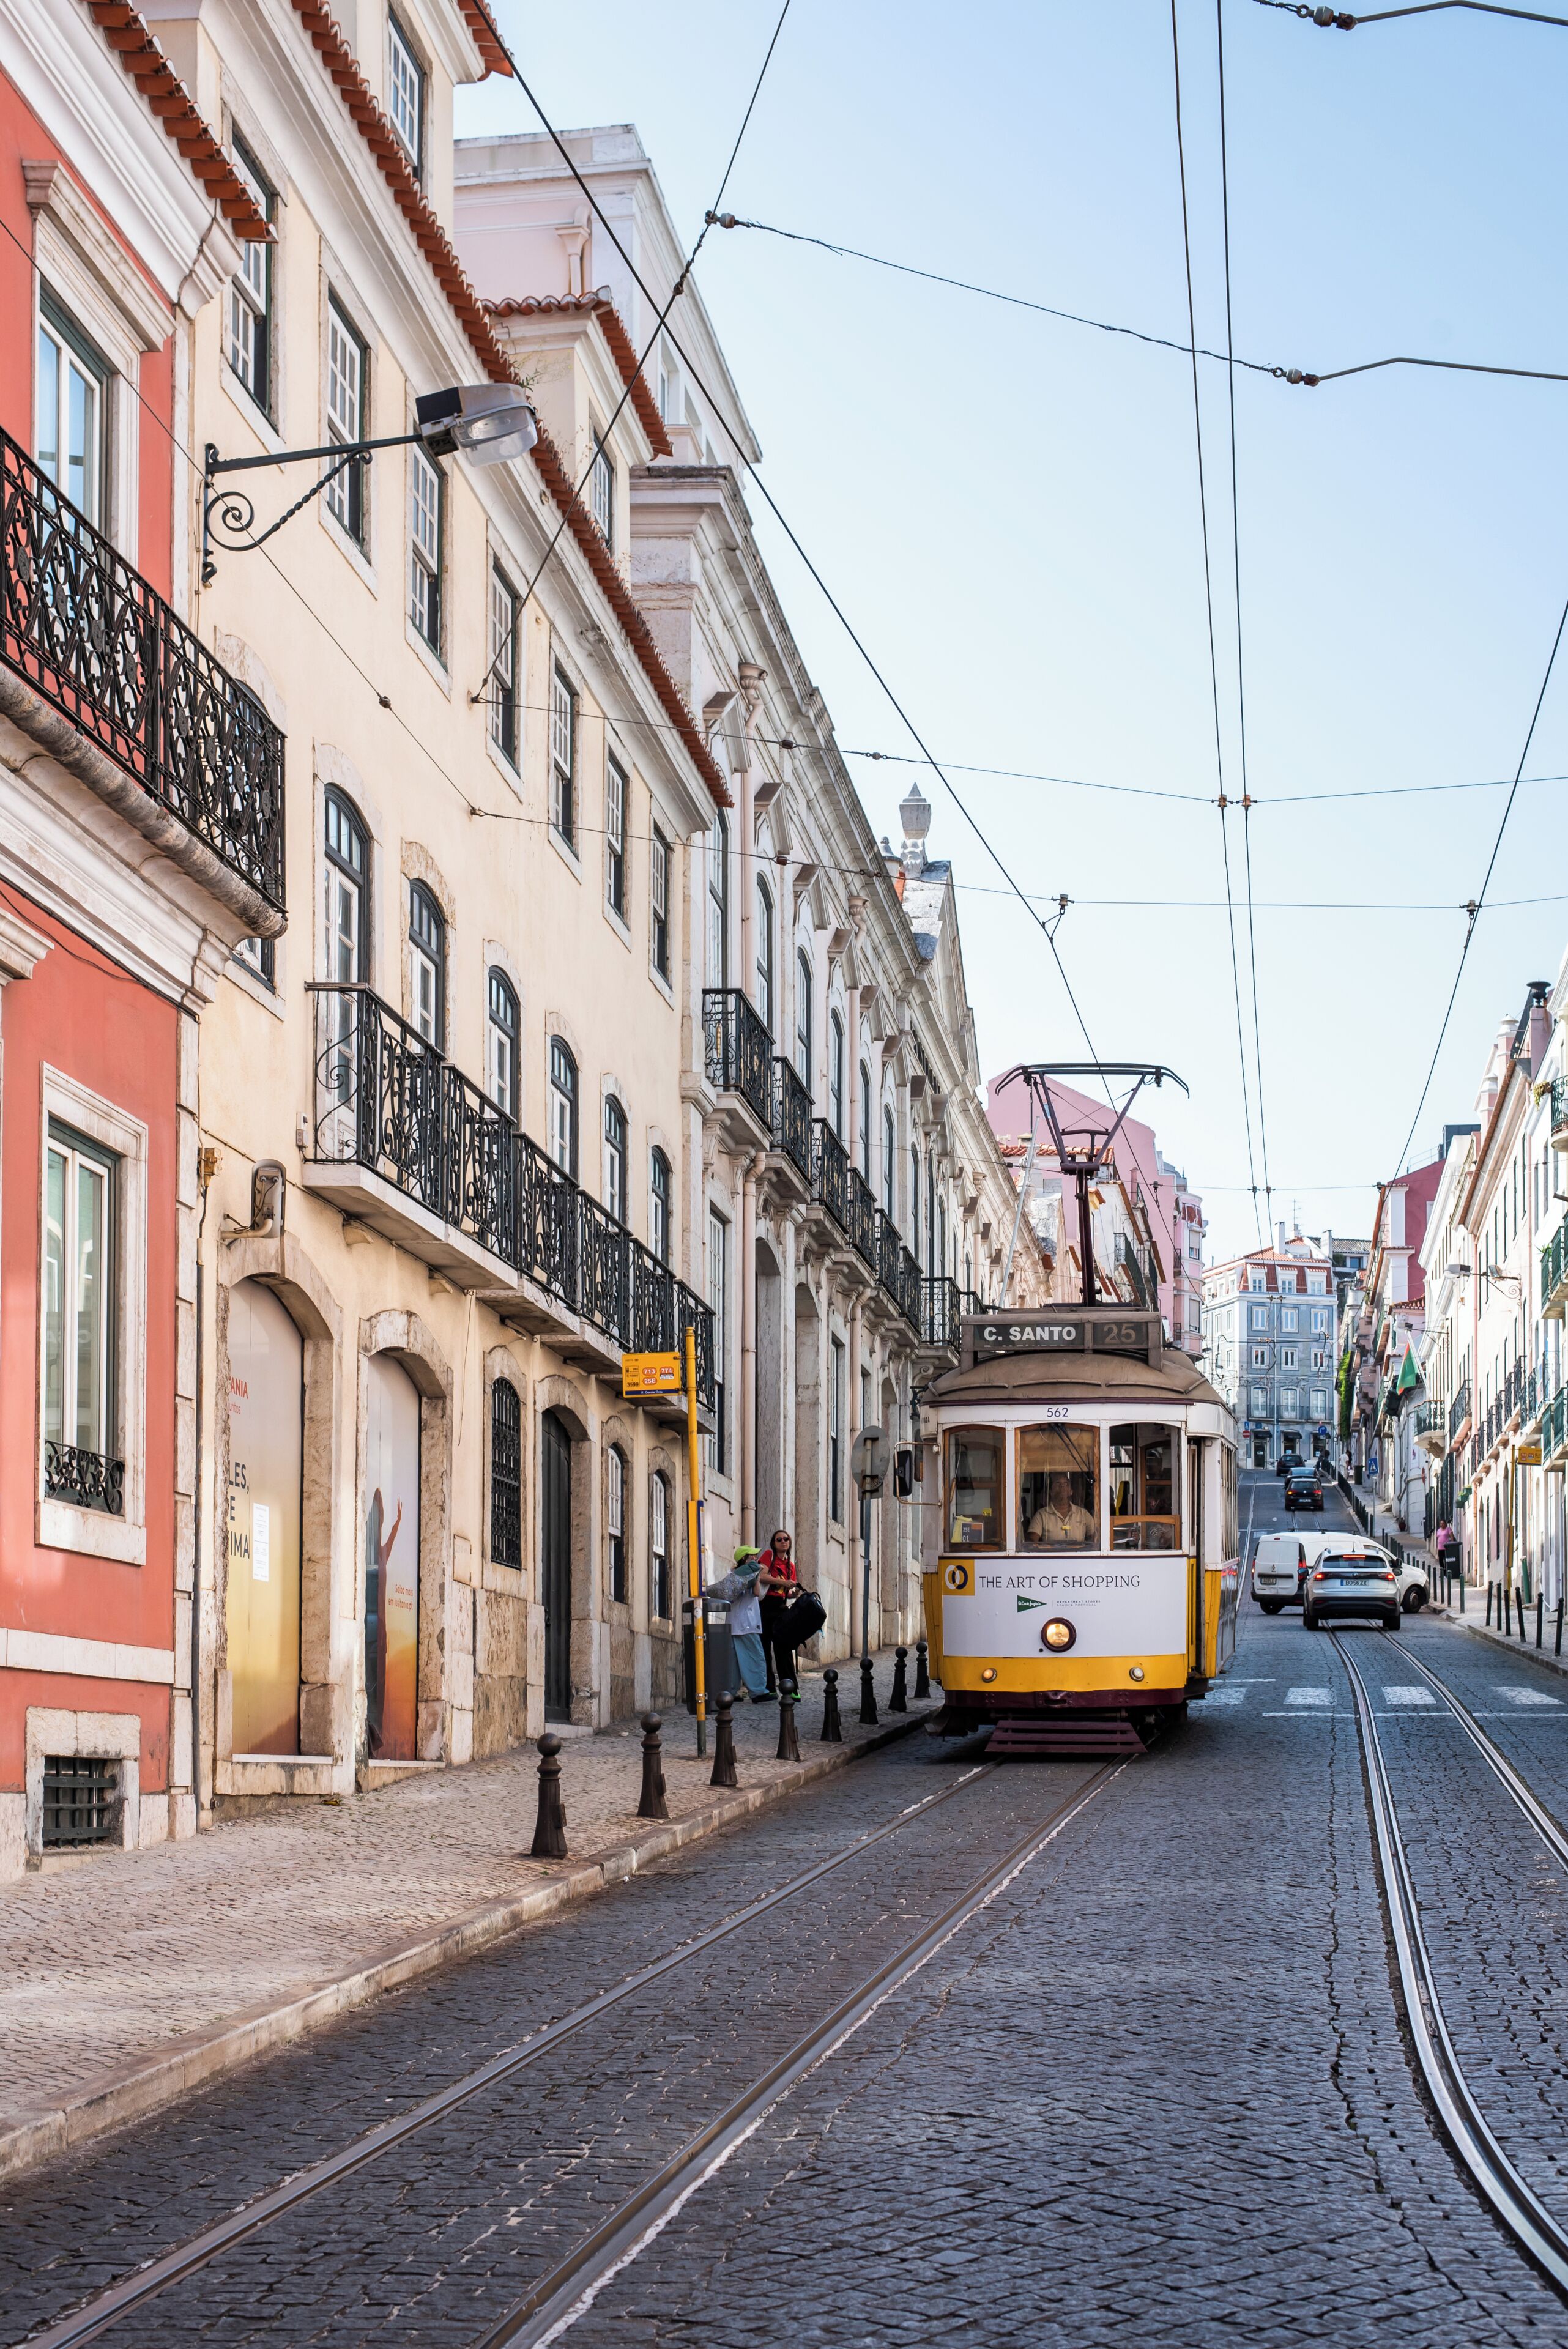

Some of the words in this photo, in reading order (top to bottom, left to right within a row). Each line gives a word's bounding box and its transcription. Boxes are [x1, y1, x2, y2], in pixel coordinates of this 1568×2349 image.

[984, 1327, 1003, 1341] C.
[1009, 1327, 1076, 1341] SANTO
[1104, 1324, 1136, 1344] 25
[229, 1375, 248, 1399] ANIA
[1047, 1407, 1069, 1417] 562
[228, 1530, 250, 1559] IMA
[395, 1584, 404, 1594] Saiba
[979, 1576, 1003, 1589] THE
[1006, 1576, 1035, 1589] ART
[1039, 1576, 1058, 1589] OF
[1062, 1575, 1141, 1589] SHOPPING
[388, 1598, 394, 1606] em
[394, 1596, 413, 1611] lusitania.pt
